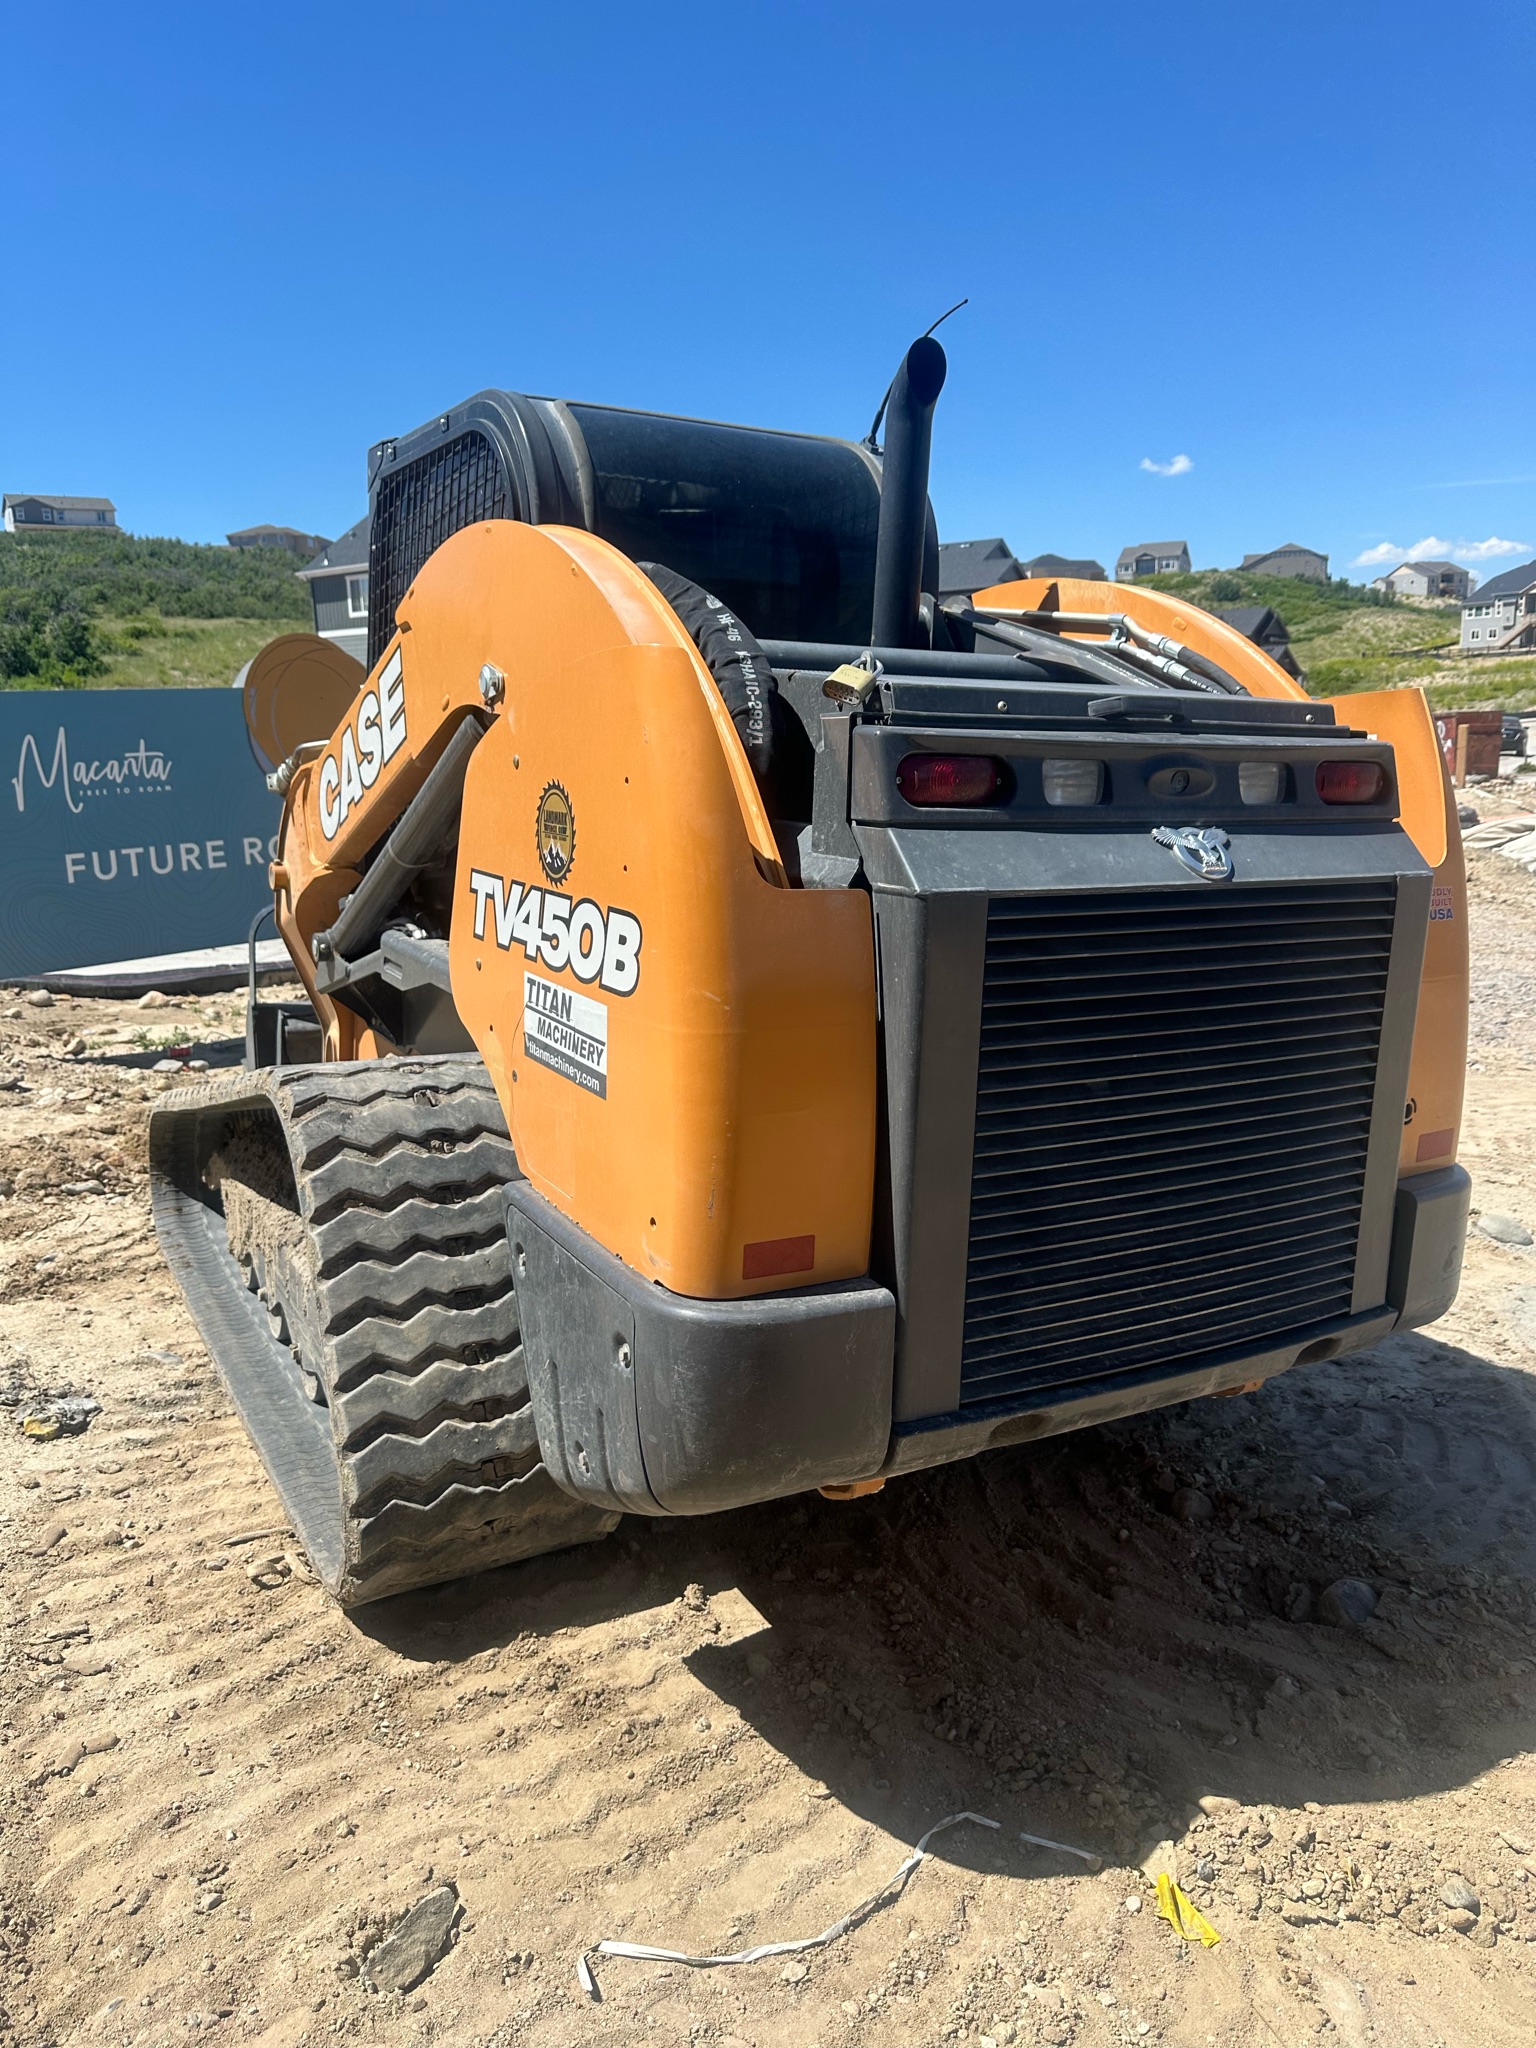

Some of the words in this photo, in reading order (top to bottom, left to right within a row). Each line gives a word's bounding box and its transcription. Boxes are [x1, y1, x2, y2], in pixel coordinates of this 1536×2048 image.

[319, 643, 407, 841] CASE
[12, 726, 172, 813] Macanta
[139, 785, 172, 793] ROAM
[65, 840, 227, 883] FUTURE
[470, 867, 642, 997] TV450B
[1429, 908, 1454, 921] USA
[526, 976, 573, 1023] TITAN
[528, 1040, 600, 1091] titanmachinery.com
[536, 1016, 604, 1067] MACHINERY
